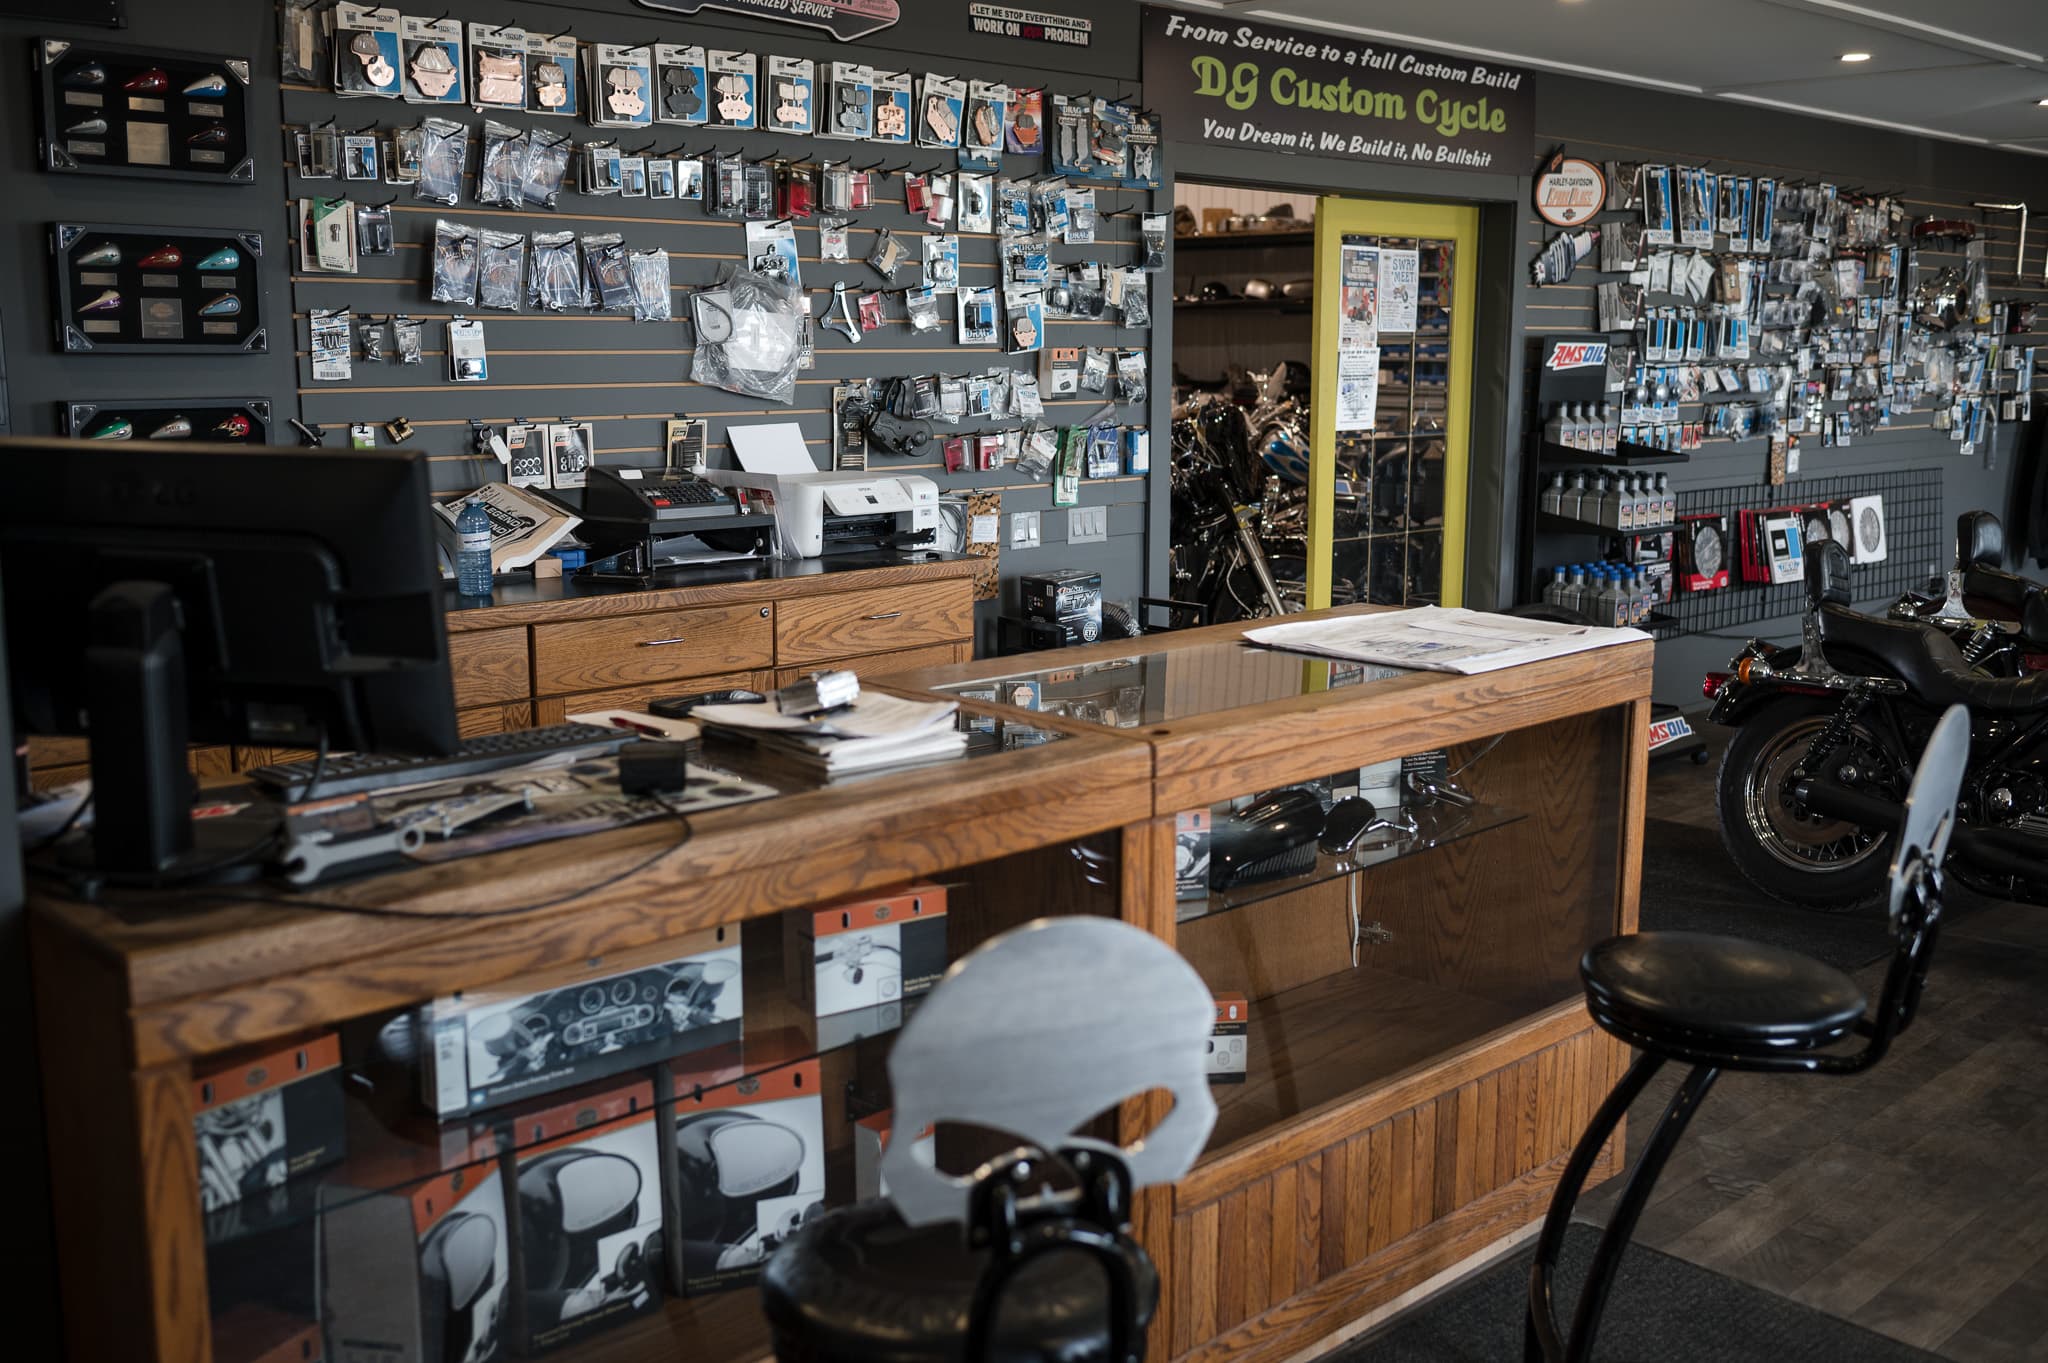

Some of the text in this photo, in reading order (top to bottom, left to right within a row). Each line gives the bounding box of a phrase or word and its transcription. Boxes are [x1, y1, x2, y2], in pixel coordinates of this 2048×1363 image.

[790, 0, 835, 18] SERVICE
[976, 5, 1085, 29] LET ME STOP EVERYTHING AND
[973, 17, 1004, 34] WORK
[1005, 21, 1020, 37] ON
[1044, 27, 1089, 46] PROBLEM
[1165, 15, 1522, 91] From Service to a full Custom Build
[1191, 55, 1507, 137] DG Custom Cycle
[1203, 117, 1493, 167] You Dream it, We Build it, No Bullshit
[1549, 177, 1593, 186] HARLEY-DAVIDSON
[1392, 258, 1416, 271] SWAP
[1393, 271, 1415, 283] MEET
[1551, 345, 1606, 367] AMSOIL
[483, 504, 521, 527] LEGEND
[1062, 588, 1099, 614] ETX
[1648, 719, 1690, 746] MSOIL
